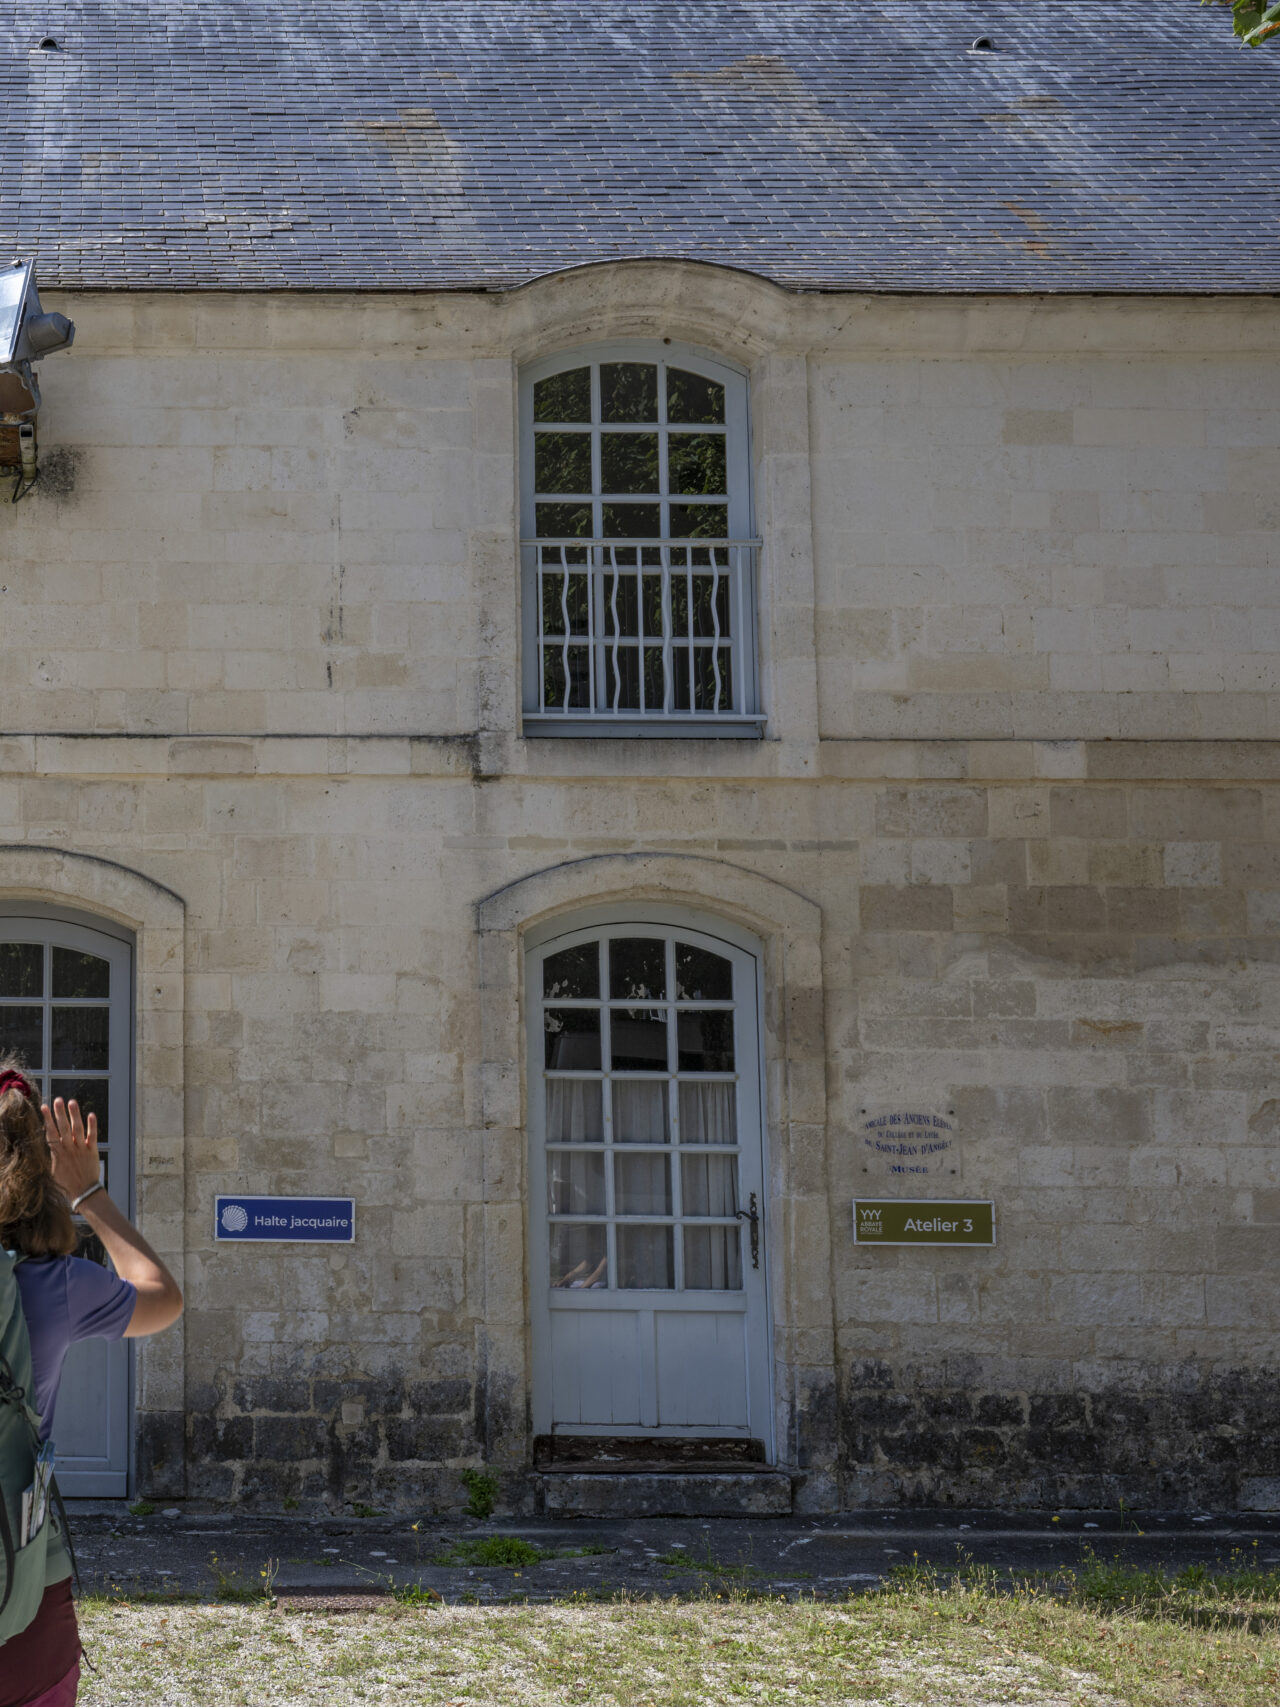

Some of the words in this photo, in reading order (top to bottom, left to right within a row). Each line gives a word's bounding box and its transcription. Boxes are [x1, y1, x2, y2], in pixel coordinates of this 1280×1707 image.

[889, 1114, 902, 1125] DES
[904, 1112, 930, 1126] ANCIENS
[254, 1215, 288, 1227] Halte
[289, 1215, 349, 1229] jacquaire
[903, 1218, 959, 1232] Atelier
[963, 1219, 974, 1232] 3
